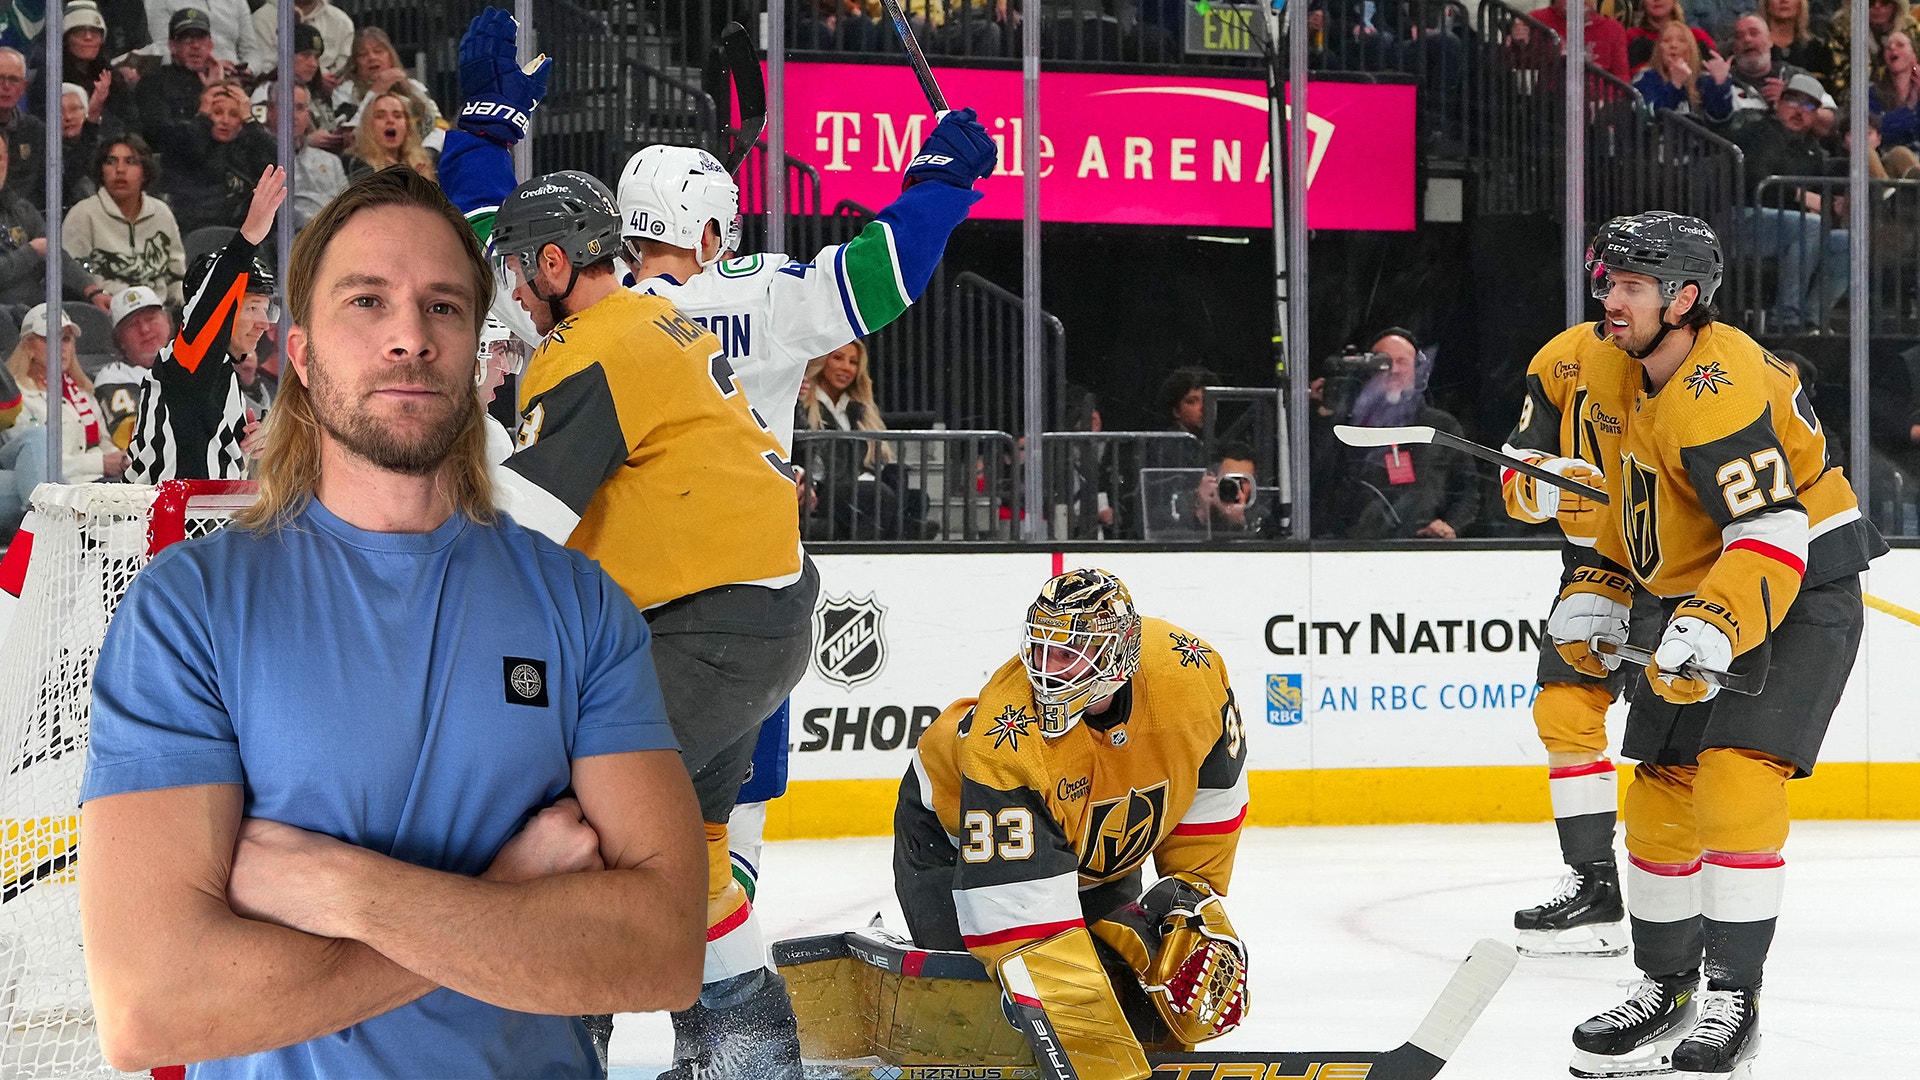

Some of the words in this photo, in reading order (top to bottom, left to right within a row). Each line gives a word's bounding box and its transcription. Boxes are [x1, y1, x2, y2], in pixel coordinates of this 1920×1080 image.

[1204, 9, 1253, 51] EXIT
[872, 113, 1056, 178] Mile
[630, 210, 649, 232] 40
[1607, 243, 1630, 254] CCM
[693, 313, 751, 359] ON
[1590, 402, 1620, 424] Circa
[1715, 447, 1795, 519] 27
[1568, 568, 1635, 595] AUER
[828, 617, 873, 668] NHL
[1370, 612, 1547, 654] NATION
[1269, 710, 1301, 724] RBC
[1320, 686, 1357, 712] AN
[1371, 685, 1428, 711] RBC
[788, 705, 942, 753] SHOP
[1057, 777, 1089, 801] Circa
[962, 806, 1035, 863] 33
